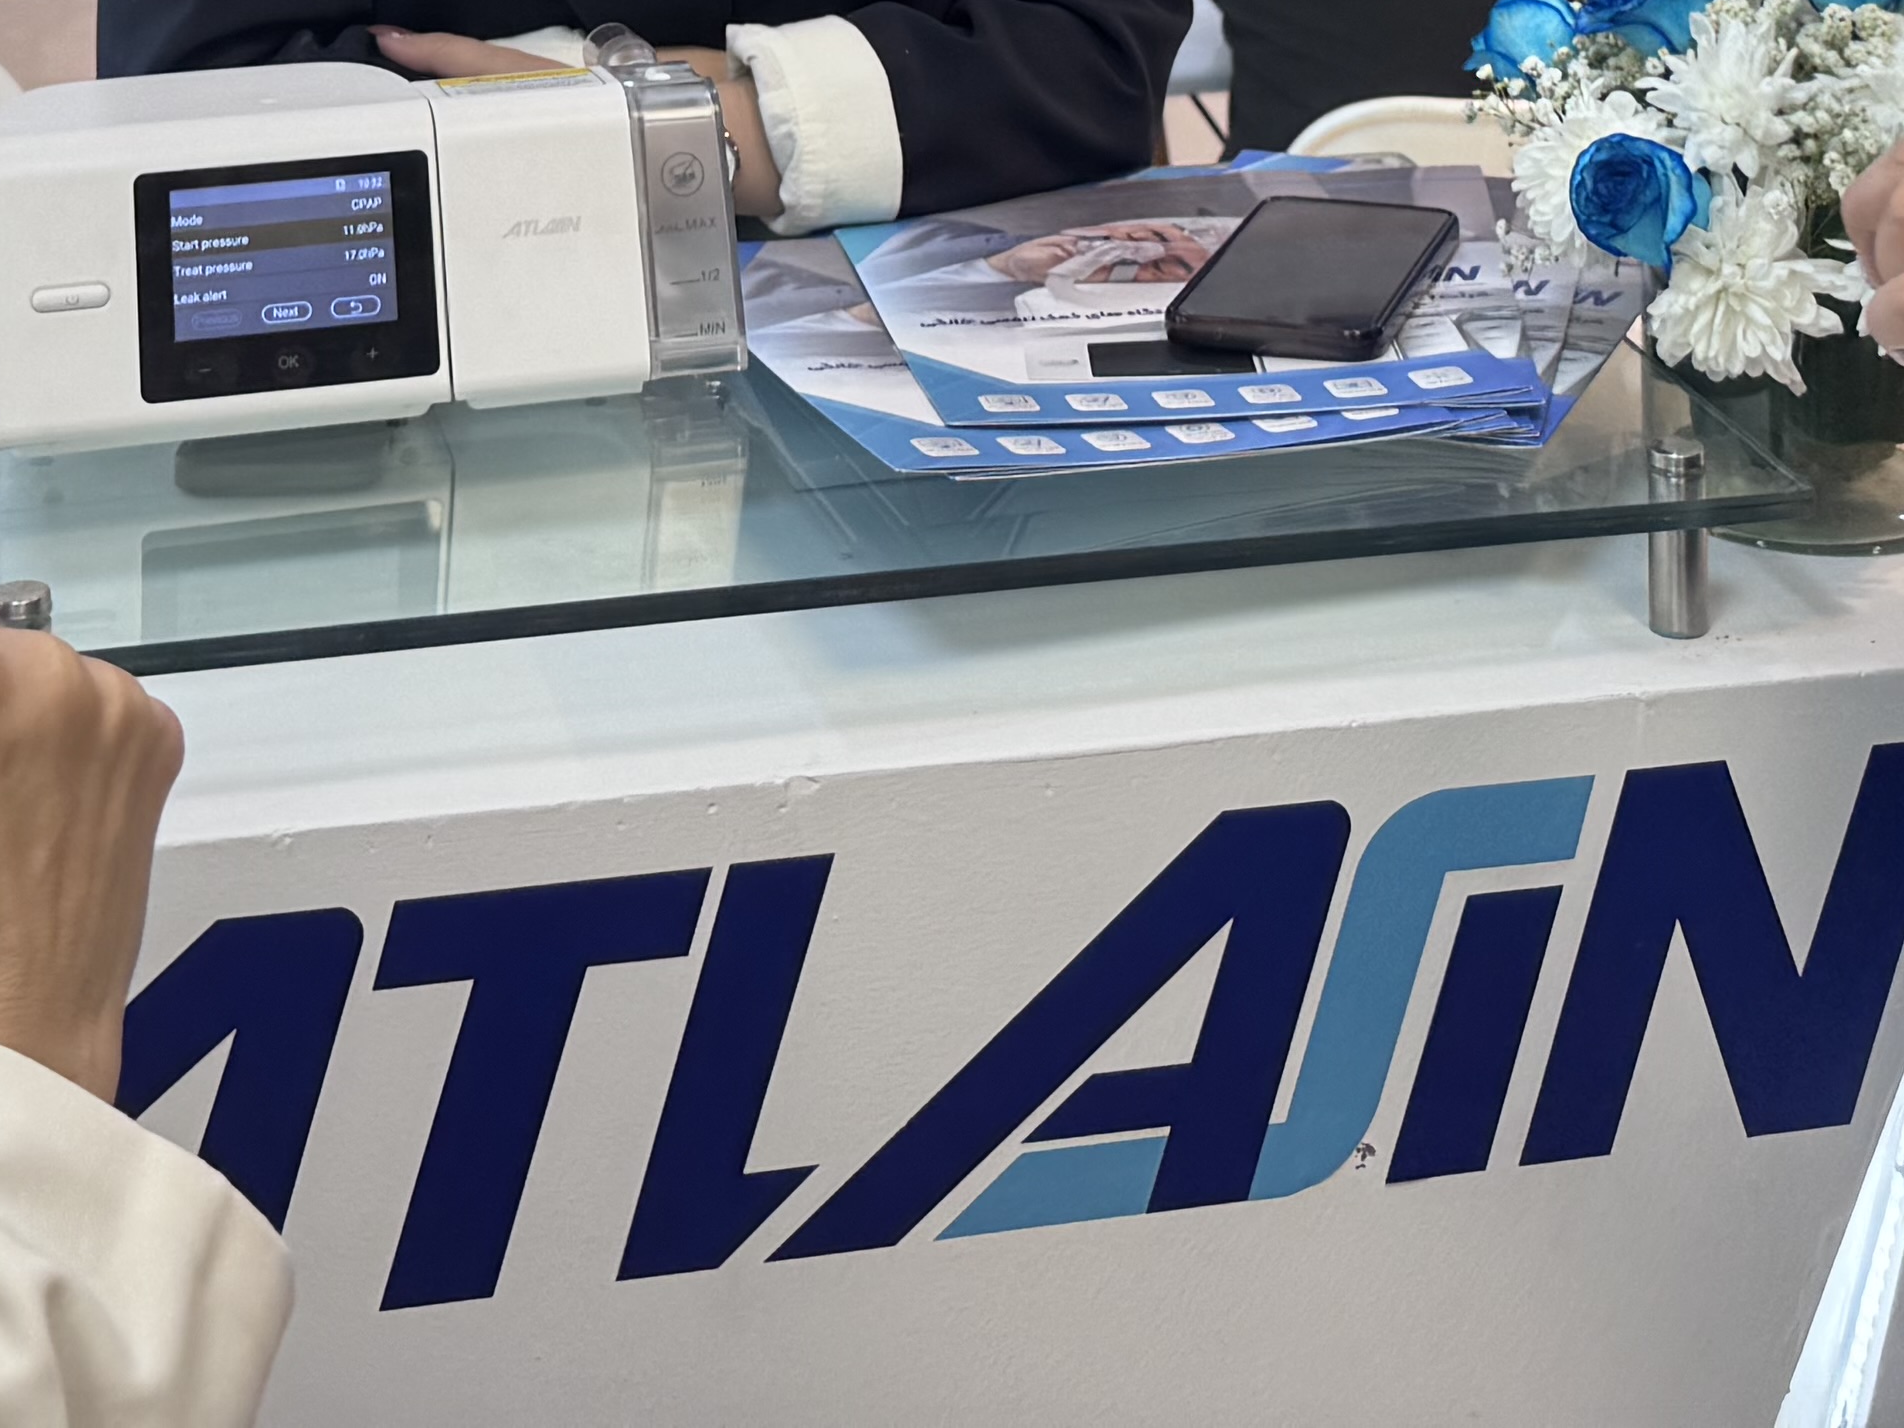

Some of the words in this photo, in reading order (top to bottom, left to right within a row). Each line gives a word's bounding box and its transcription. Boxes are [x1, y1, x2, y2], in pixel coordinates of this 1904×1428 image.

[171, 214, 204, 229] Mode
[351, 196, 383, 212] CPAP
[172, 239, 199, 253] Start
[201, 235, 249, 252] pressure
[174, 265, 203, 279] Treat
[205, 260, 253, 277] pressure
[700, 267, 721, 281] 1/2
[174, 293, 201, 306] Leak
[202, 288, 227, 303] alert
[369, 272, 387, 286] ON
[273, 304, 299, 319] Next
[700, 321, 726, 336] MIN
[278, 355, 299, 369] OK
